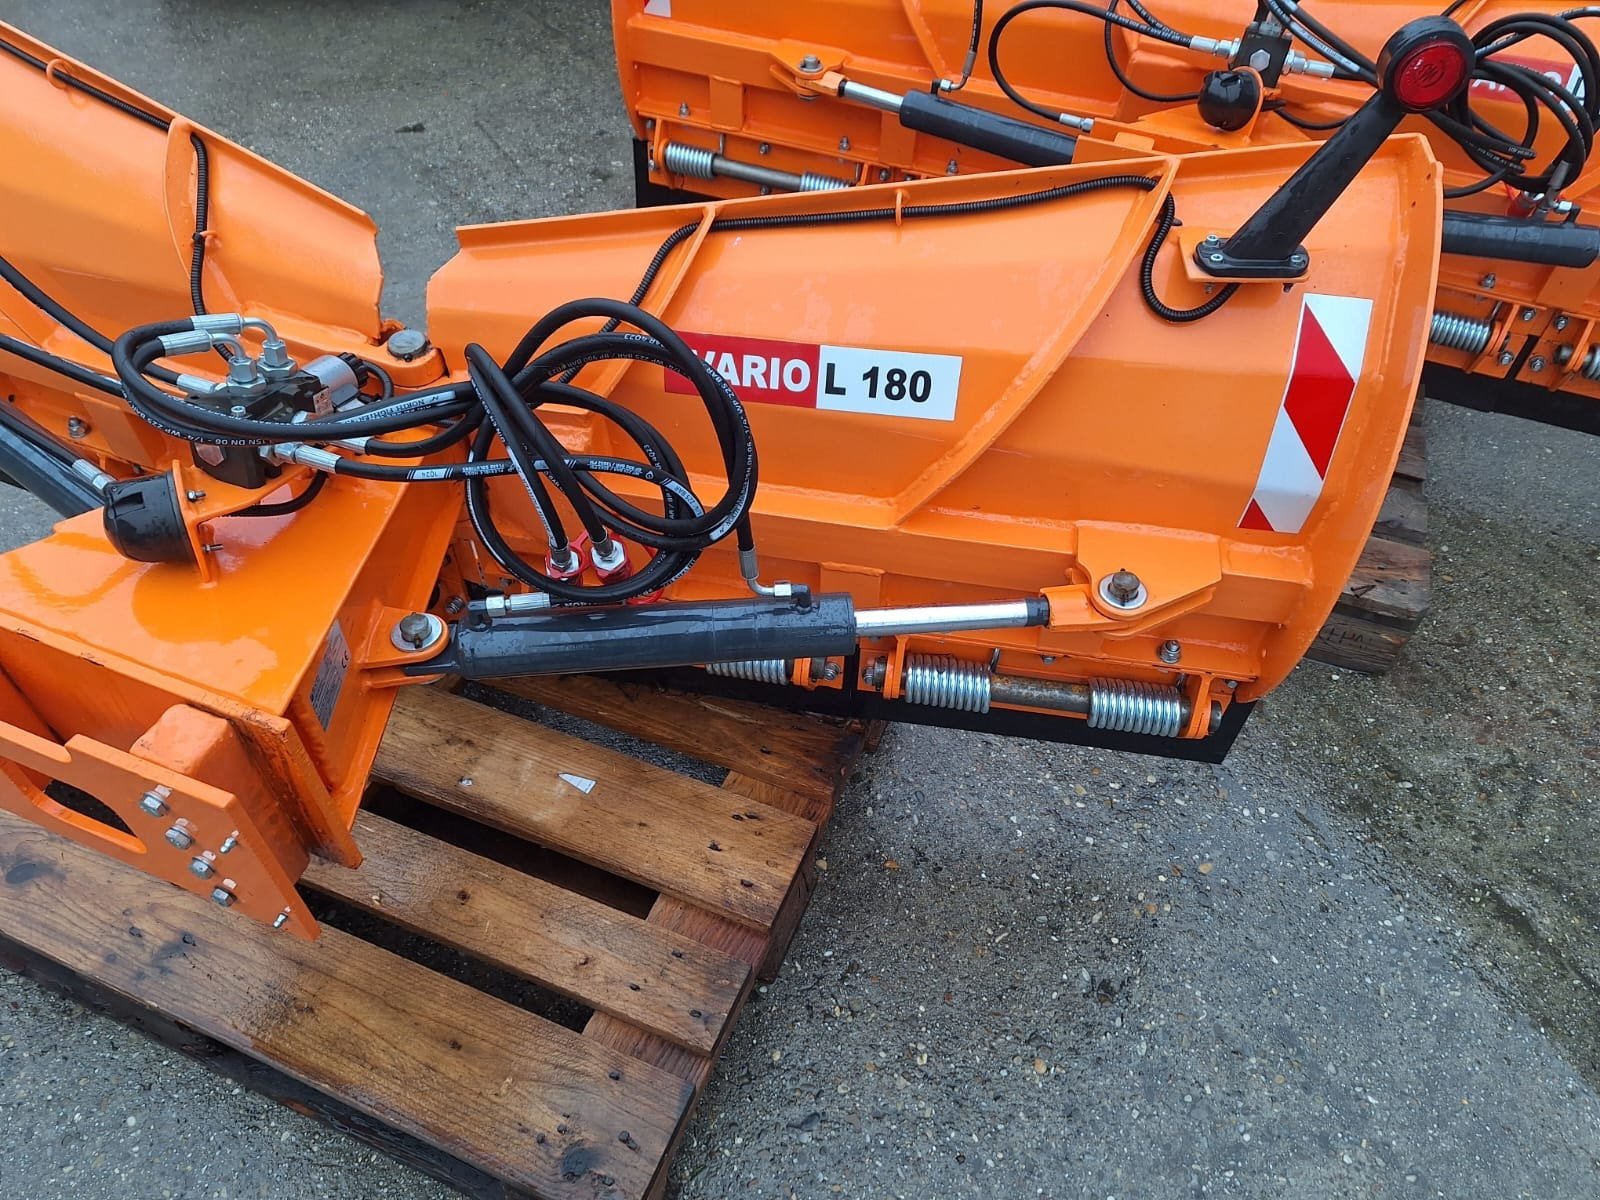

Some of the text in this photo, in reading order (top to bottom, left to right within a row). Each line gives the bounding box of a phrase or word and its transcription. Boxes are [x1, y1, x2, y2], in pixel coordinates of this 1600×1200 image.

[706, 367, 722, 383] BAR
[824, 362, 846, 396] L
[861, 366, 932, 403] 180
[721, 383, 735, 399] 225
[149, 417, 164, 430] 225
[164, 428, 181, 438] WP
[215, 438, 227, 446] 06
[231, 438, 246, 446] DN
